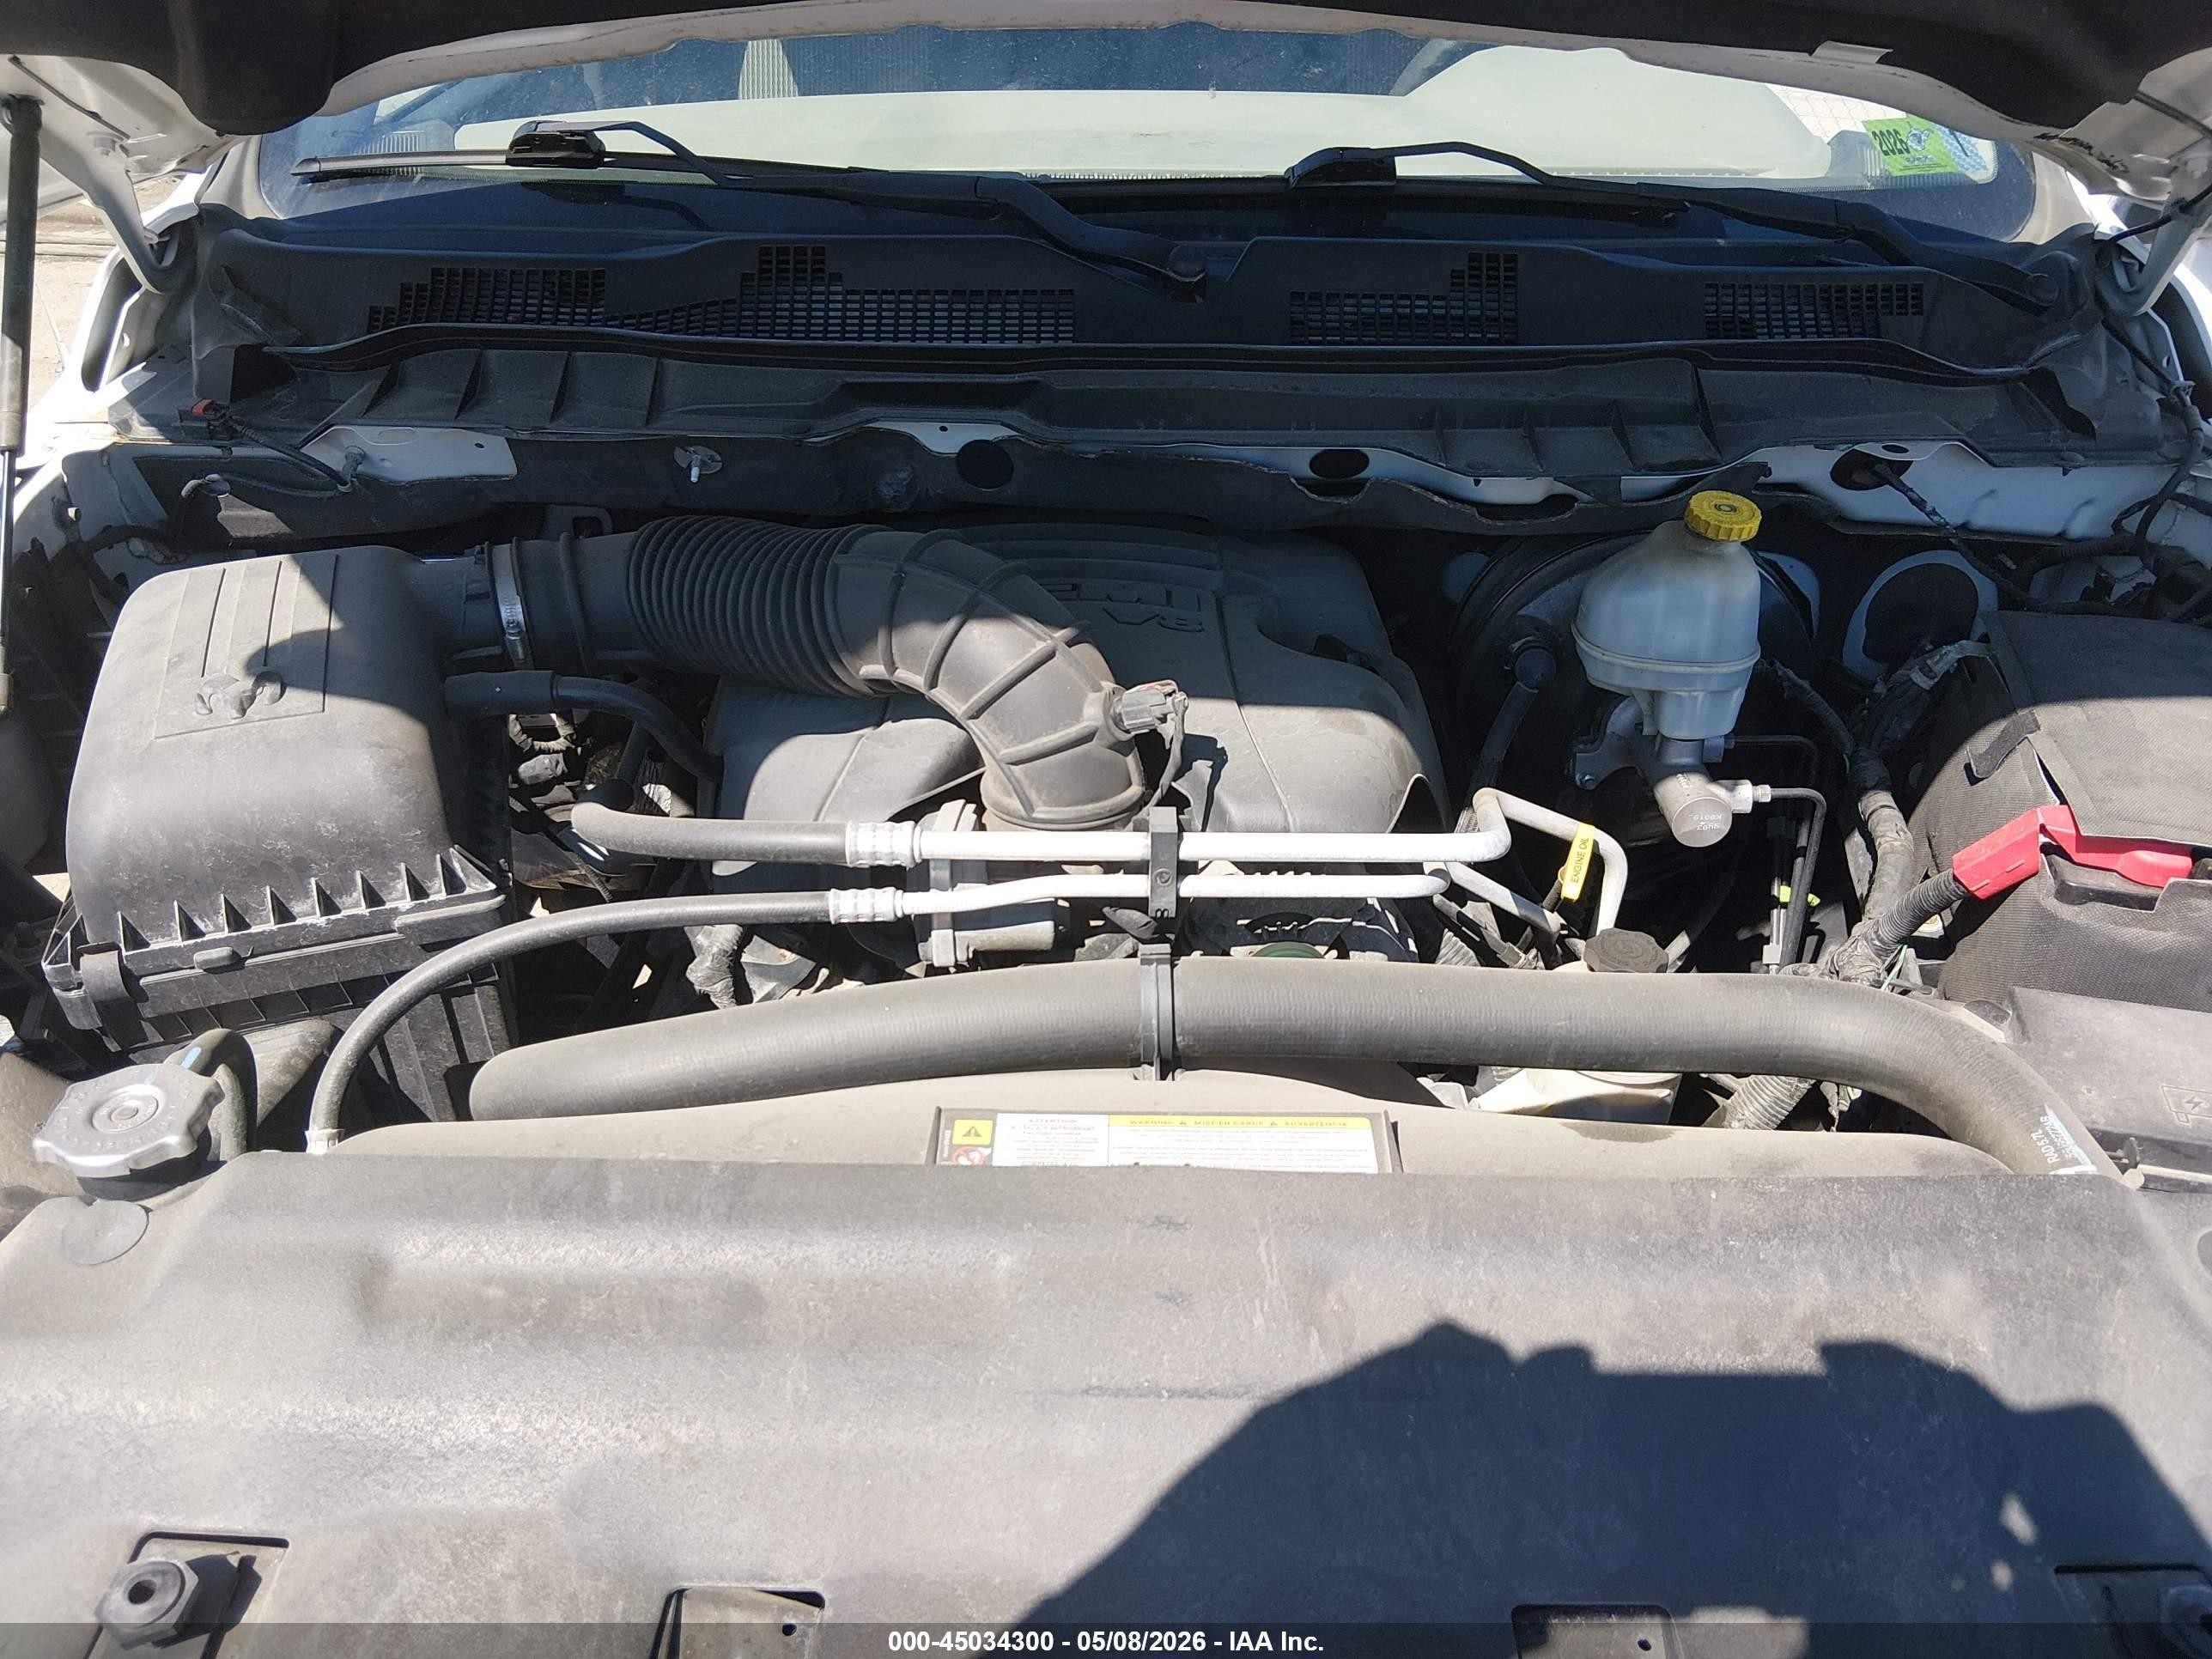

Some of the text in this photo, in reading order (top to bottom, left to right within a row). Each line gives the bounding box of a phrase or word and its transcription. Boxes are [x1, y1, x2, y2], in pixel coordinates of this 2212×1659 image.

[1871, 128, 1911, 156] 2026
[1570, 837, 1590, 884] ENGINE OIL
[2041, 1145, 2061, 1164] RAD
